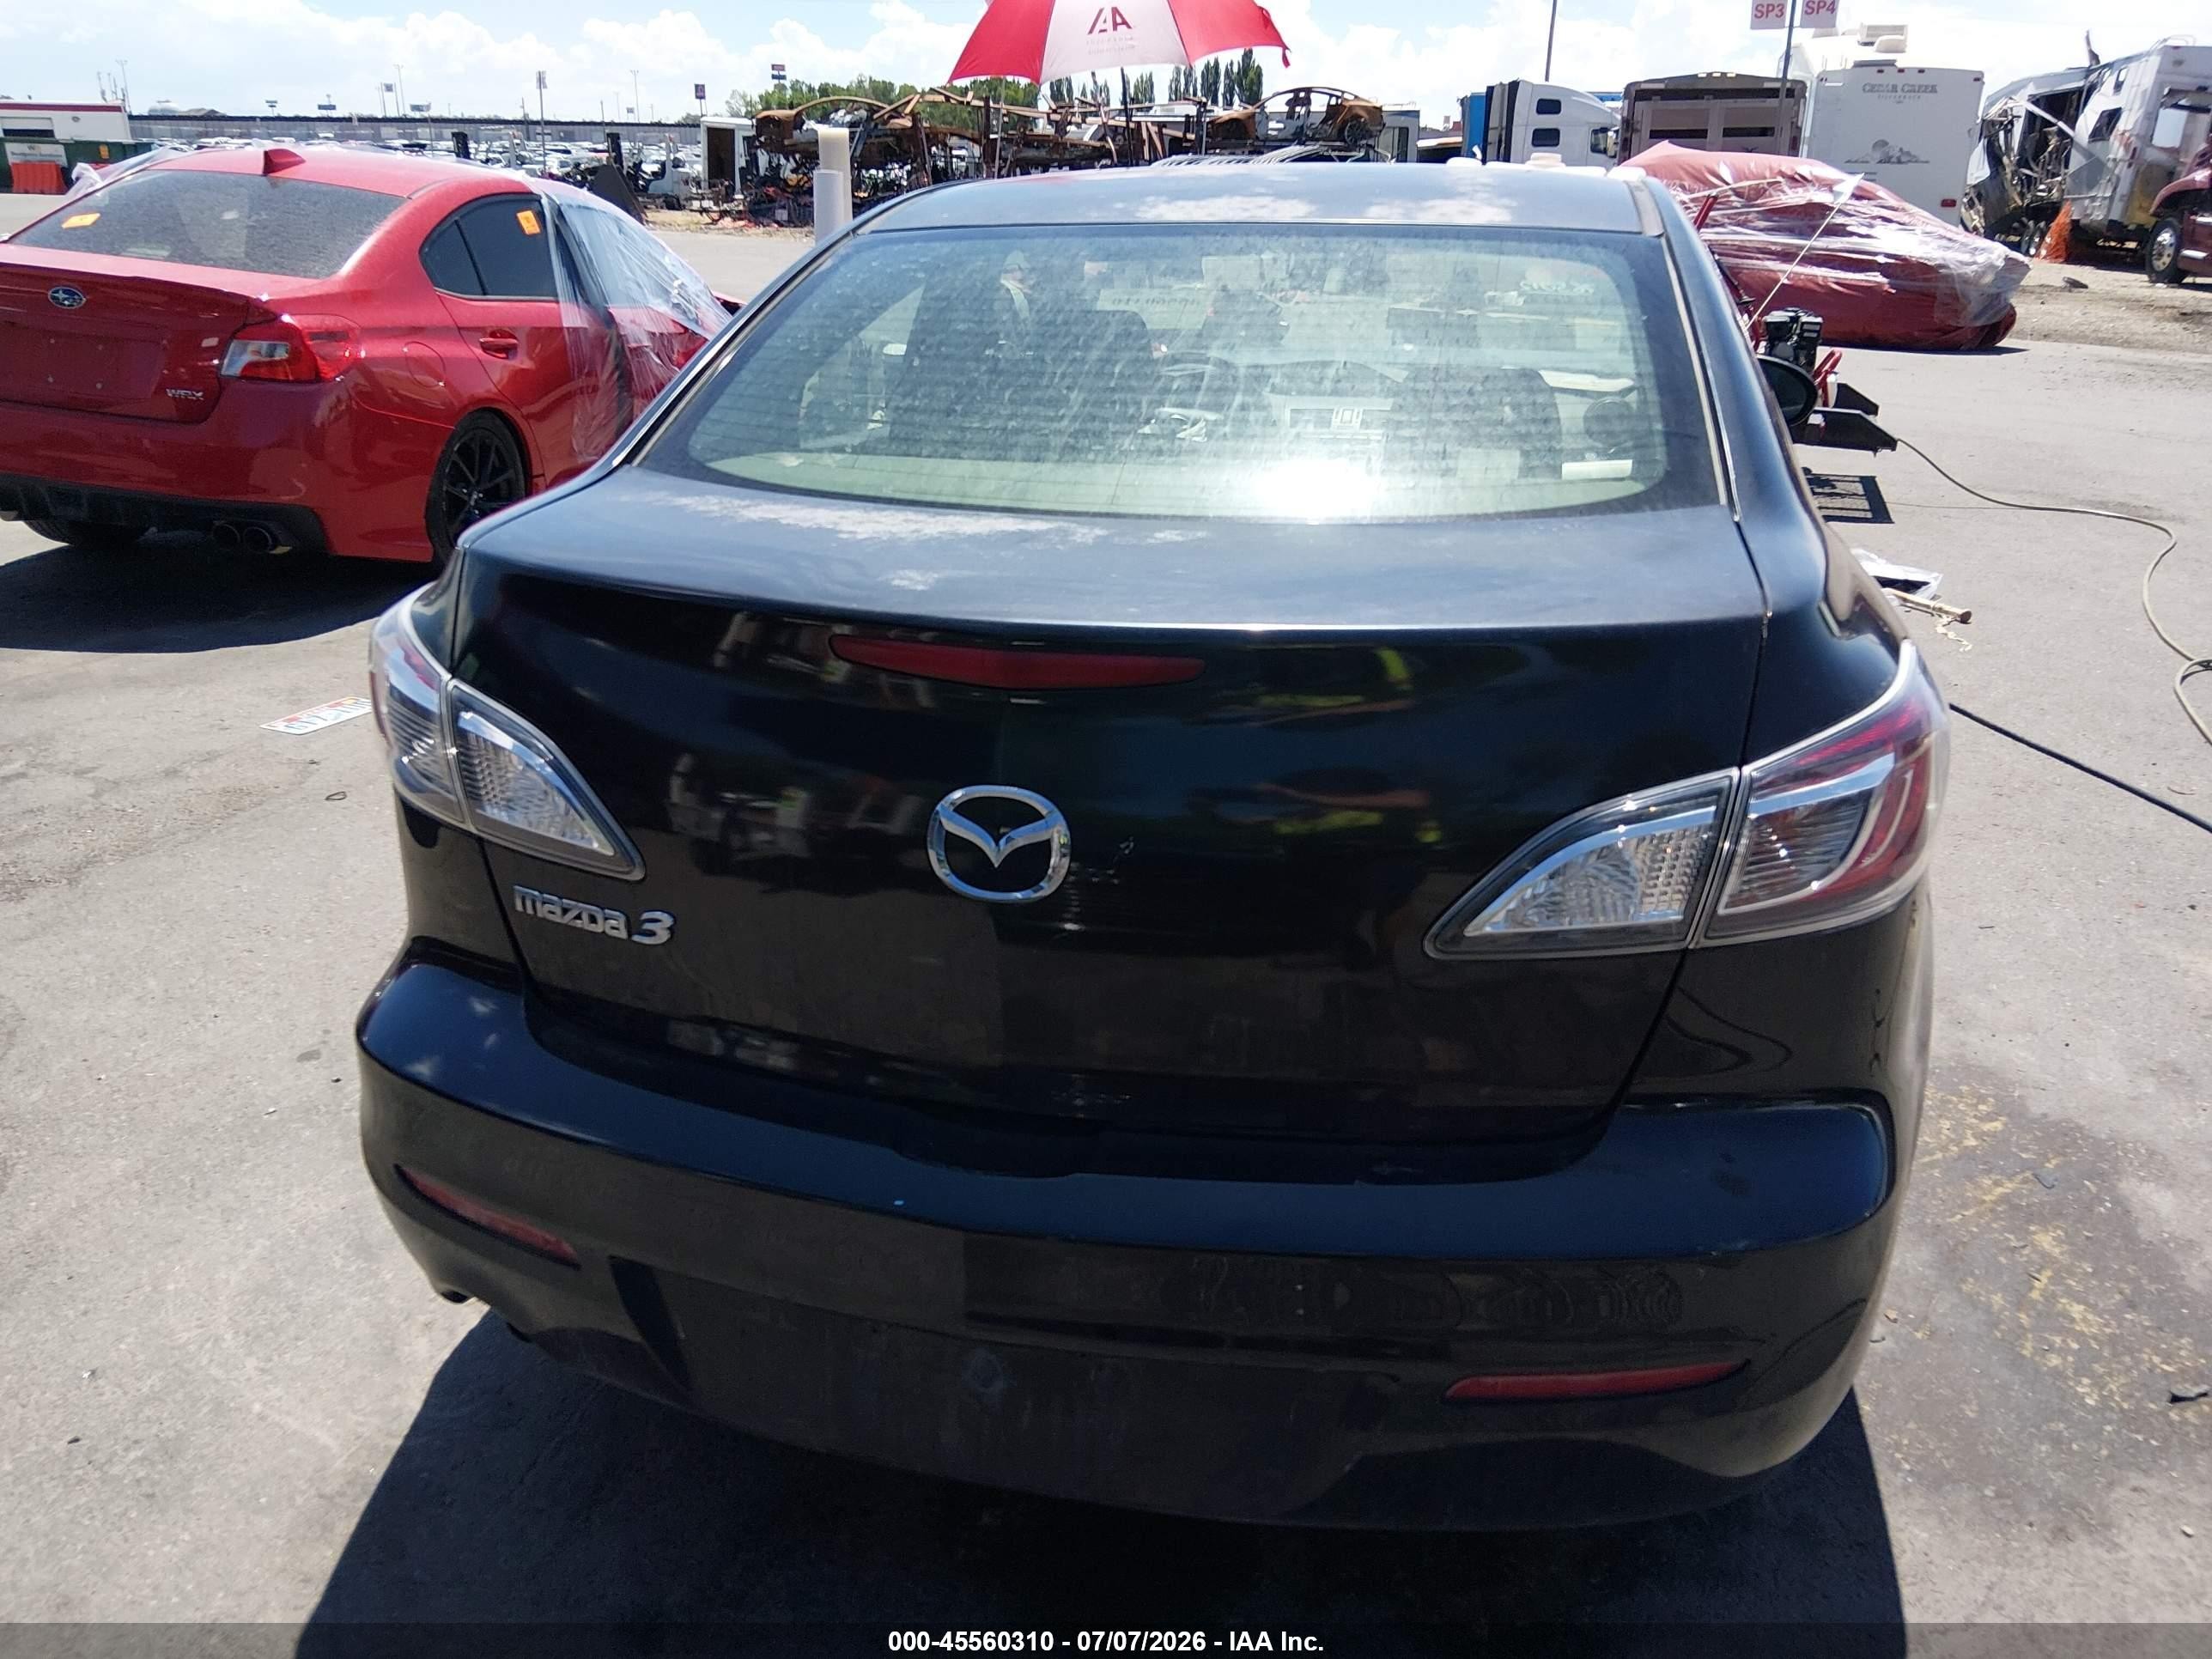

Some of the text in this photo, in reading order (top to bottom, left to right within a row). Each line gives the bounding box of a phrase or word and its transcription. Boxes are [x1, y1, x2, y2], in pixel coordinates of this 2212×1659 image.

[1753, 3, 1785, 19] SP3
[1804, 0, 1836, 15] SP4
[1901, 83, 1938, 94] CREEK
[166, 388, 204, 401] WRX
